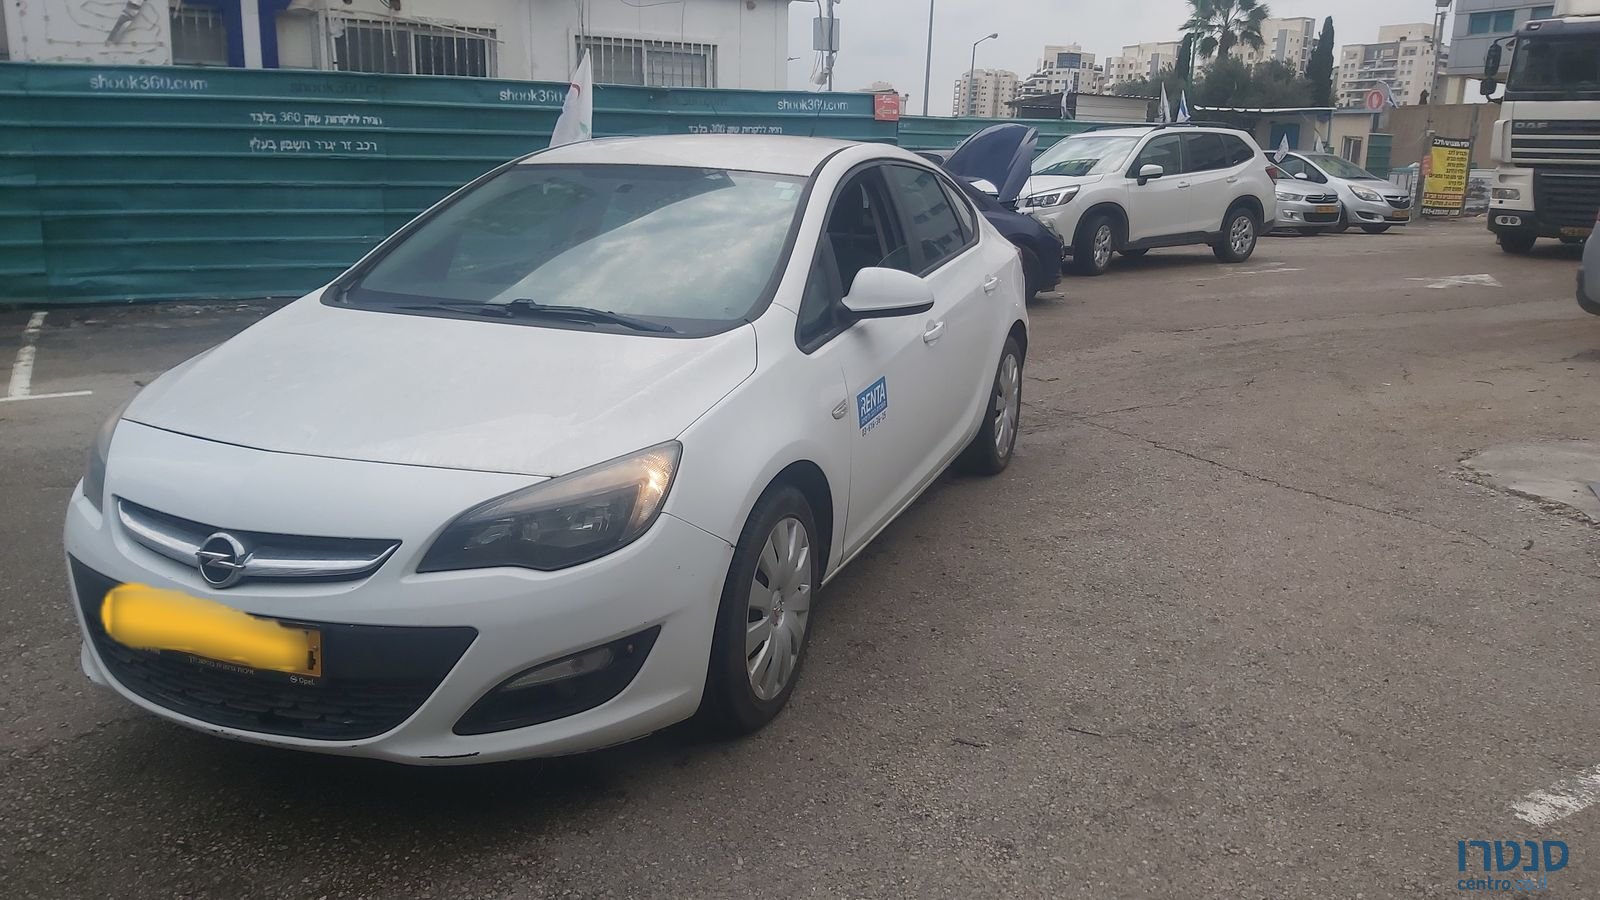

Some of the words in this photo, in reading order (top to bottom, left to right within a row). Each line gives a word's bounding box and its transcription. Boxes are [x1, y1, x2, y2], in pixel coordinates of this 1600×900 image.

[89, 74, 208, 90] shook360.com
[279, 111, 301, 123] 360
[339, 140, 352, 151] זר
[355, 141, 378, 152] רכב
[860, 381, 886, 418] RENTA
